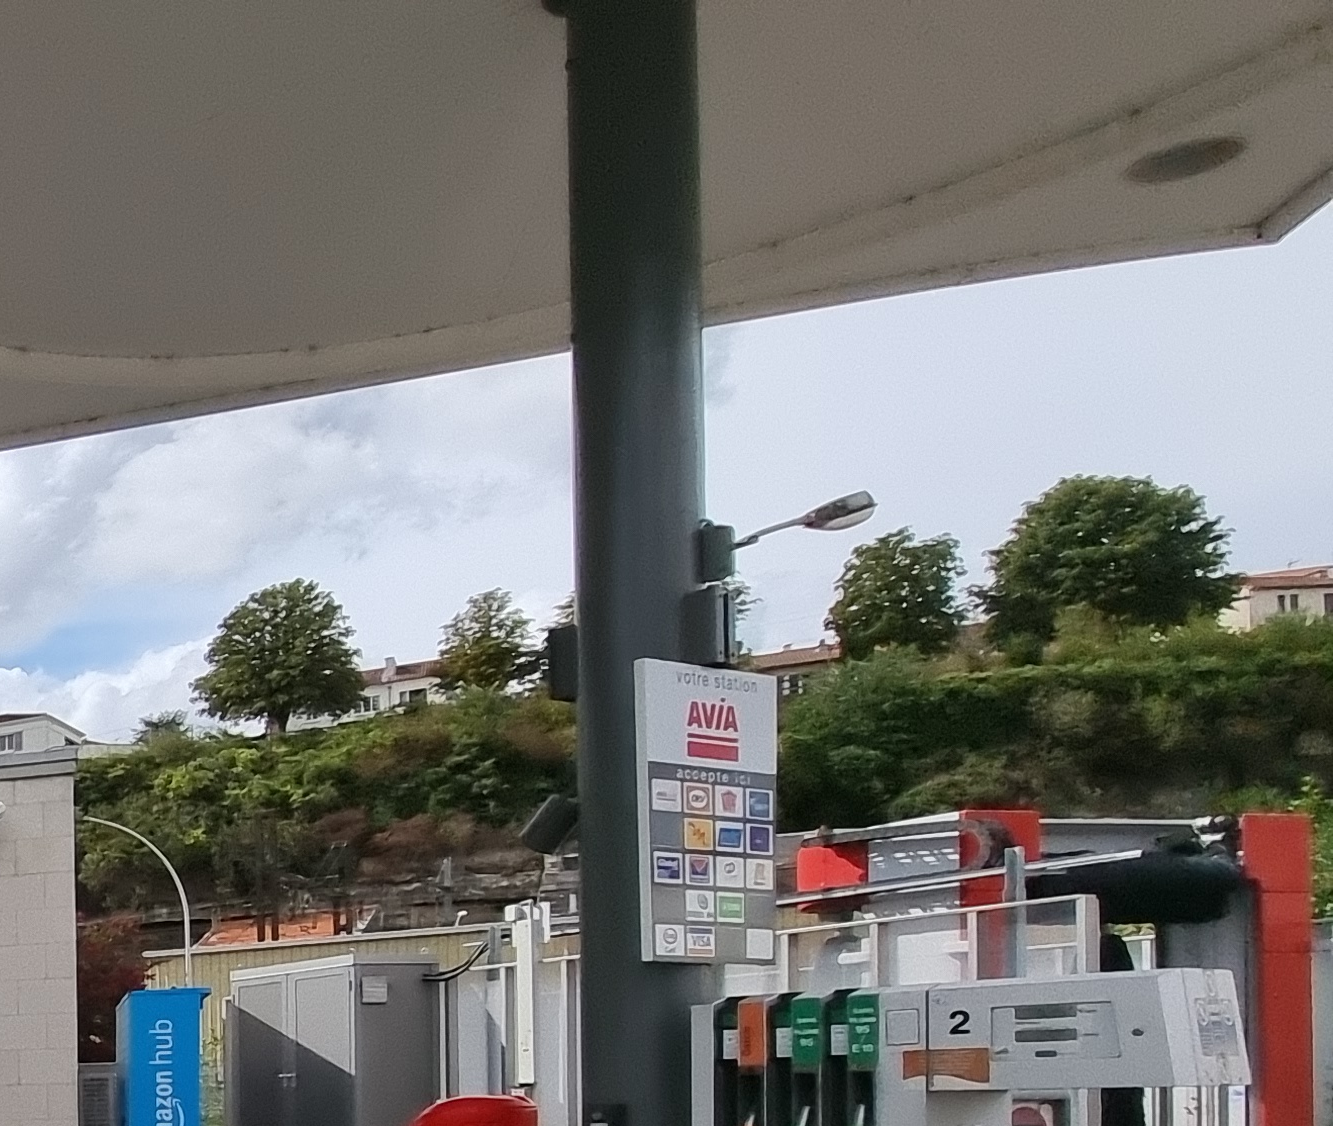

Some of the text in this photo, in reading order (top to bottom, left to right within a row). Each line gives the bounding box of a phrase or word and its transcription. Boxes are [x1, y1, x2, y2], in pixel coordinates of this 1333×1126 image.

[676, 672, 758, 693] votre station
[676, 768, 729, 784] accepte
[949, 1010, 971, 1035] 2
[148, 1019, 174, 1065] hub
